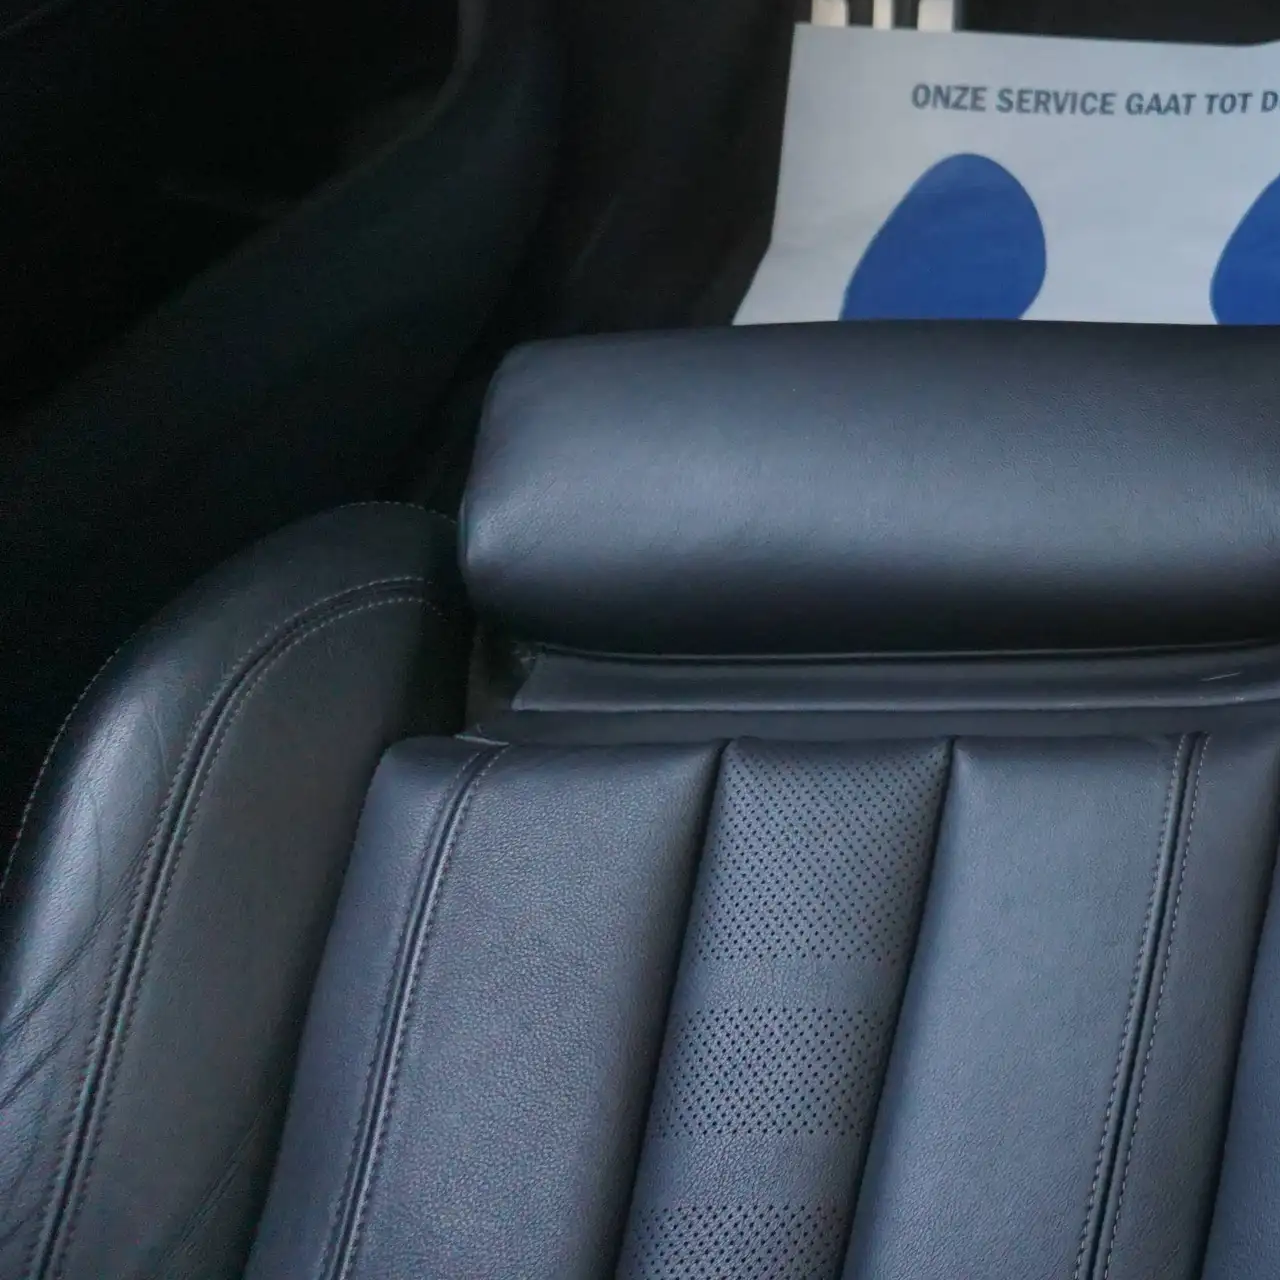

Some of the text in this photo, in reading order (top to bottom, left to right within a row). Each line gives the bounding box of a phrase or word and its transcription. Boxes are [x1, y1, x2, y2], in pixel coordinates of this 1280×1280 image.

[911, 83, 988, 113] ONZE
[995, 88, 1117, 116] SERVICE
[1125, 92, 1197, 116] GAAT
[1204, 92, 1253, 115] TOT
